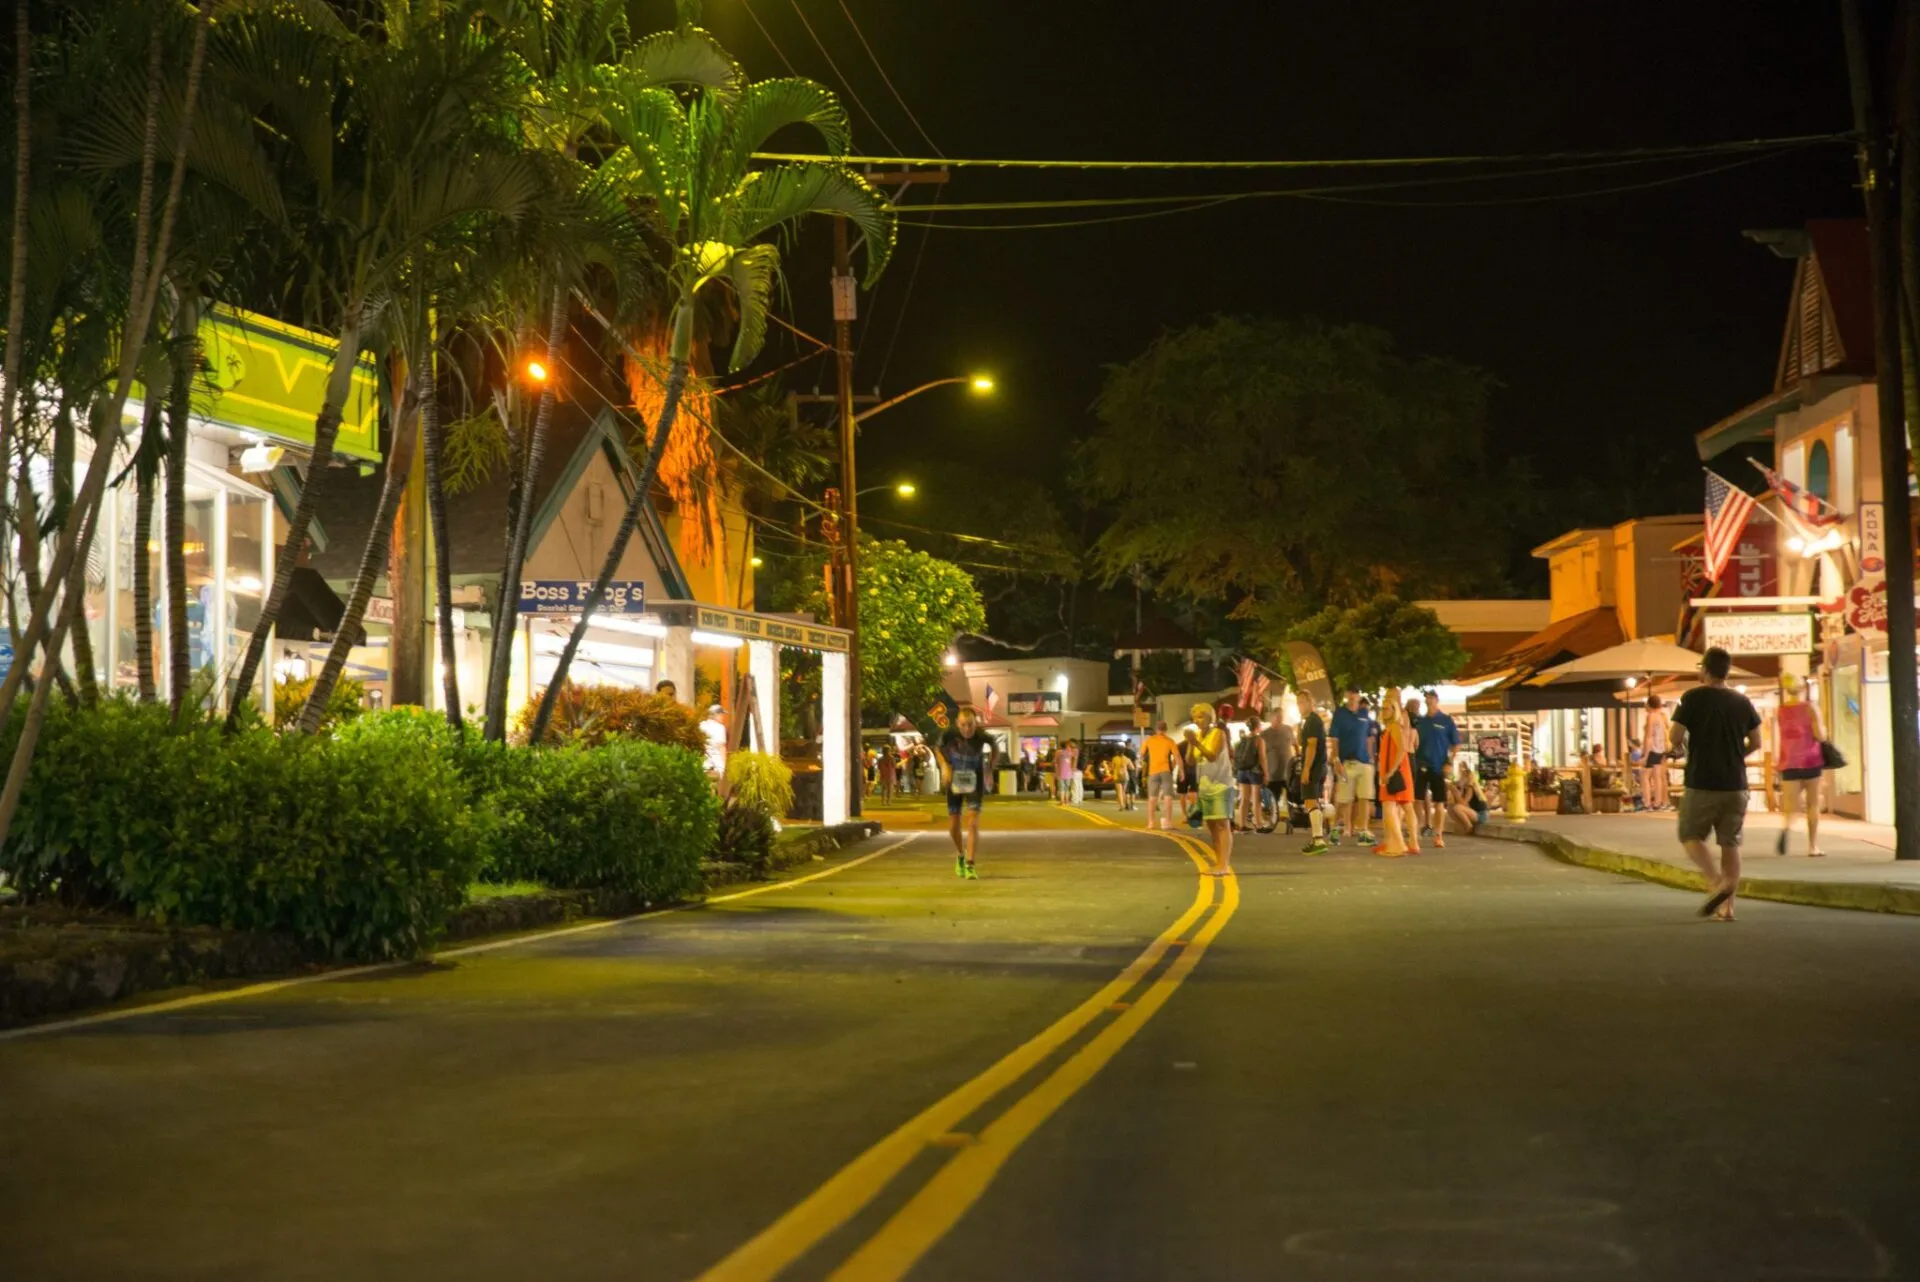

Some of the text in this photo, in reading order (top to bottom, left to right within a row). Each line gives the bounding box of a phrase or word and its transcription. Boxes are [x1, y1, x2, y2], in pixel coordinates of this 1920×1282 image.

[1865, 509, 1879, 552] KONA
[519, 581, 643, 607] Boss Fog's
[1708, 633, 1808, 650] THAI RESTAURANT
